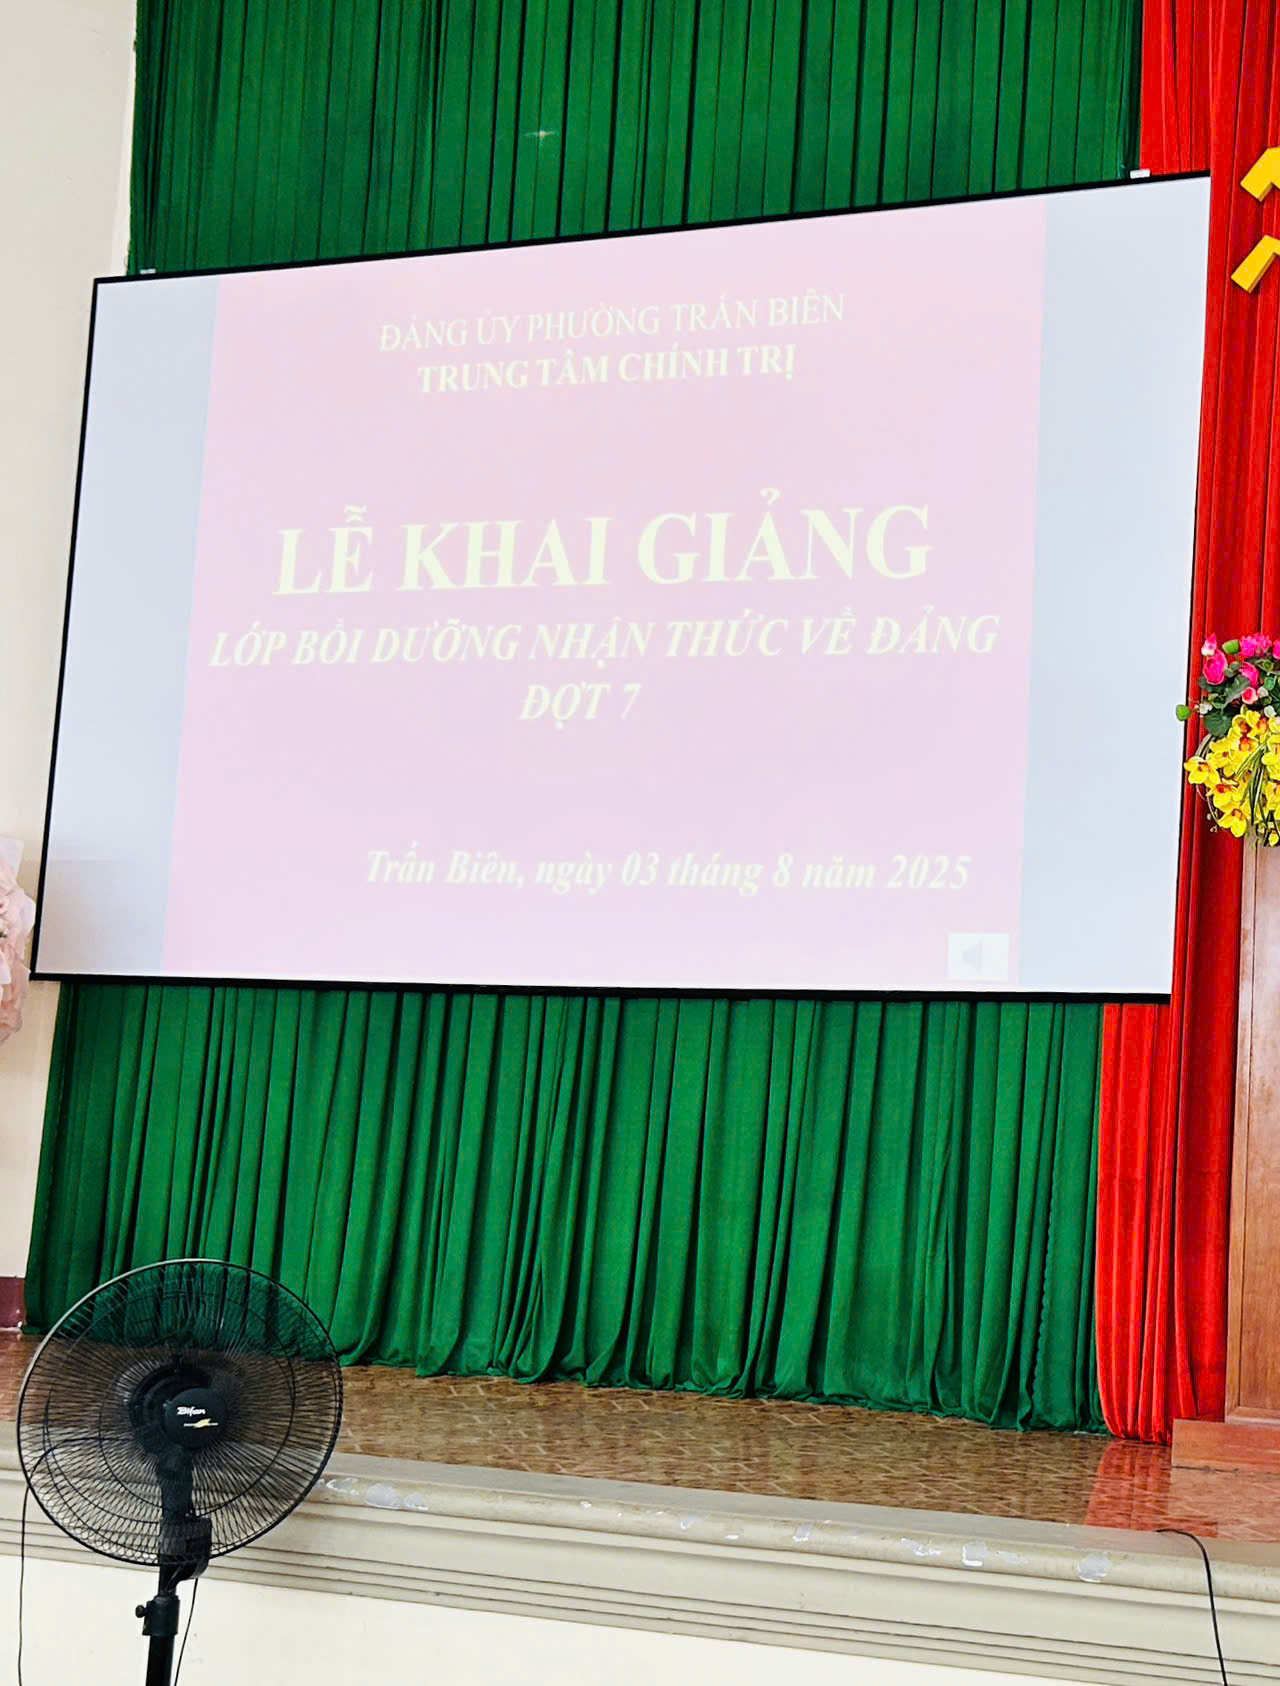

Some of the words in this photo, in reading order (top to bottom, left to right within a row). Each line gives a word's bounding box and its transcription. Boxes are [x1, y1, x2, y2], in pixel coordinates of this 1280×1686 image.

[767, 287, 847, 327] BIÊN
[417, 360, 529, 394] TRUNG
[535, 347, 609, 388] TÂM
[618, 340, 729, 383] CHÍNH
[735, 342, 797, 382] TRỊ
[272, 503, 376, 597] LỄ
[396, 512, 616, 593] KHAI
[637, 486, 935, 586] GIẢNG
[207, 620, 288, 667] LỚP
[290, 616, 367, 665] BỒI
[370, 617, 523, 666] DƯỠNG
[527, 615, 656, 671] NHẬN
[663, 607, 790, 658] THỨC
[801, 603, 857, 656] VỀ
[516, 680, 611, 734] ĐỢT
[619, 682, 643, 721] 7
[444, 848, 526, 889] Biên,
[535, 849, 614, 897] ngày
[620, 848, 661, 887] 03
[665, 851, 764, 897] tháng
[771, 850, 795, 888] 8
[800, 854, 877, 889] năm
[884, 853, 973, 889] 2025
